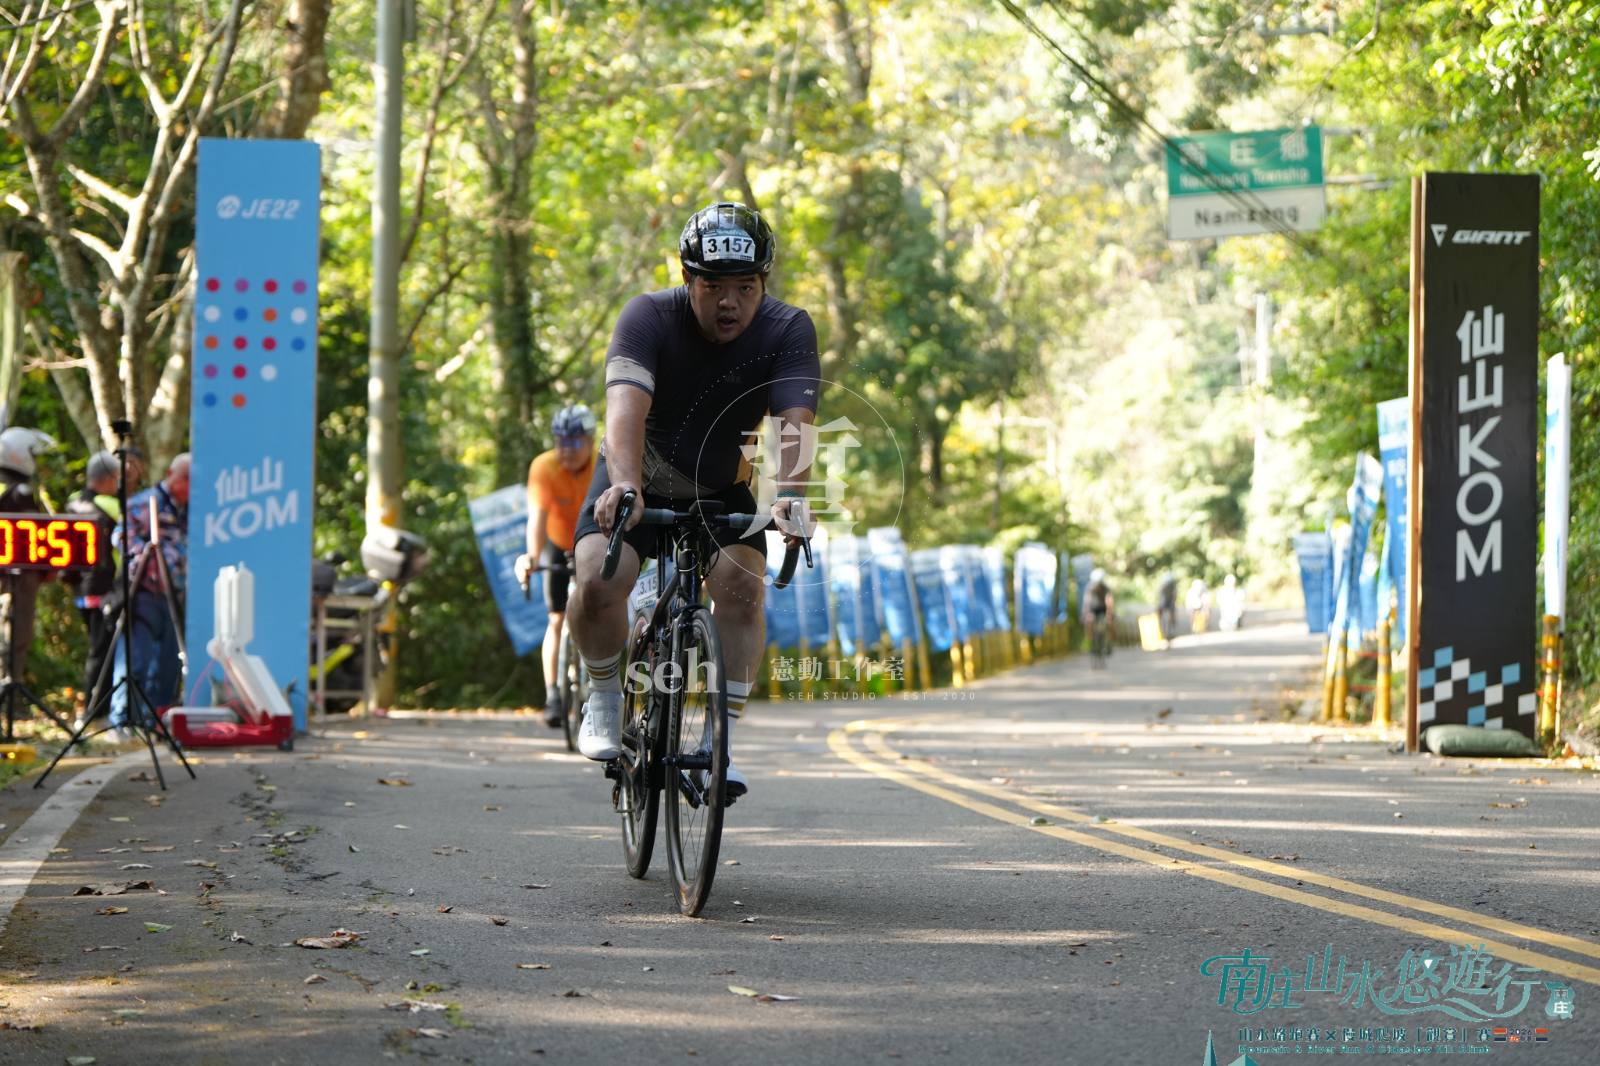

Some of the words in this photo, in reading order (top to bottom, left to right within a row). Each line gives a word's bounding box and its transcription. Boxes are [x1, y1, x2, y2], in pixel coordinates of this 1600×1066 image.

[241, 198, 301, 220] JE22
[1452, 229, 1531, 246] GIANT
[214, 455, 284, 508] 仙山
[204, 488, 299, 547] KOM
